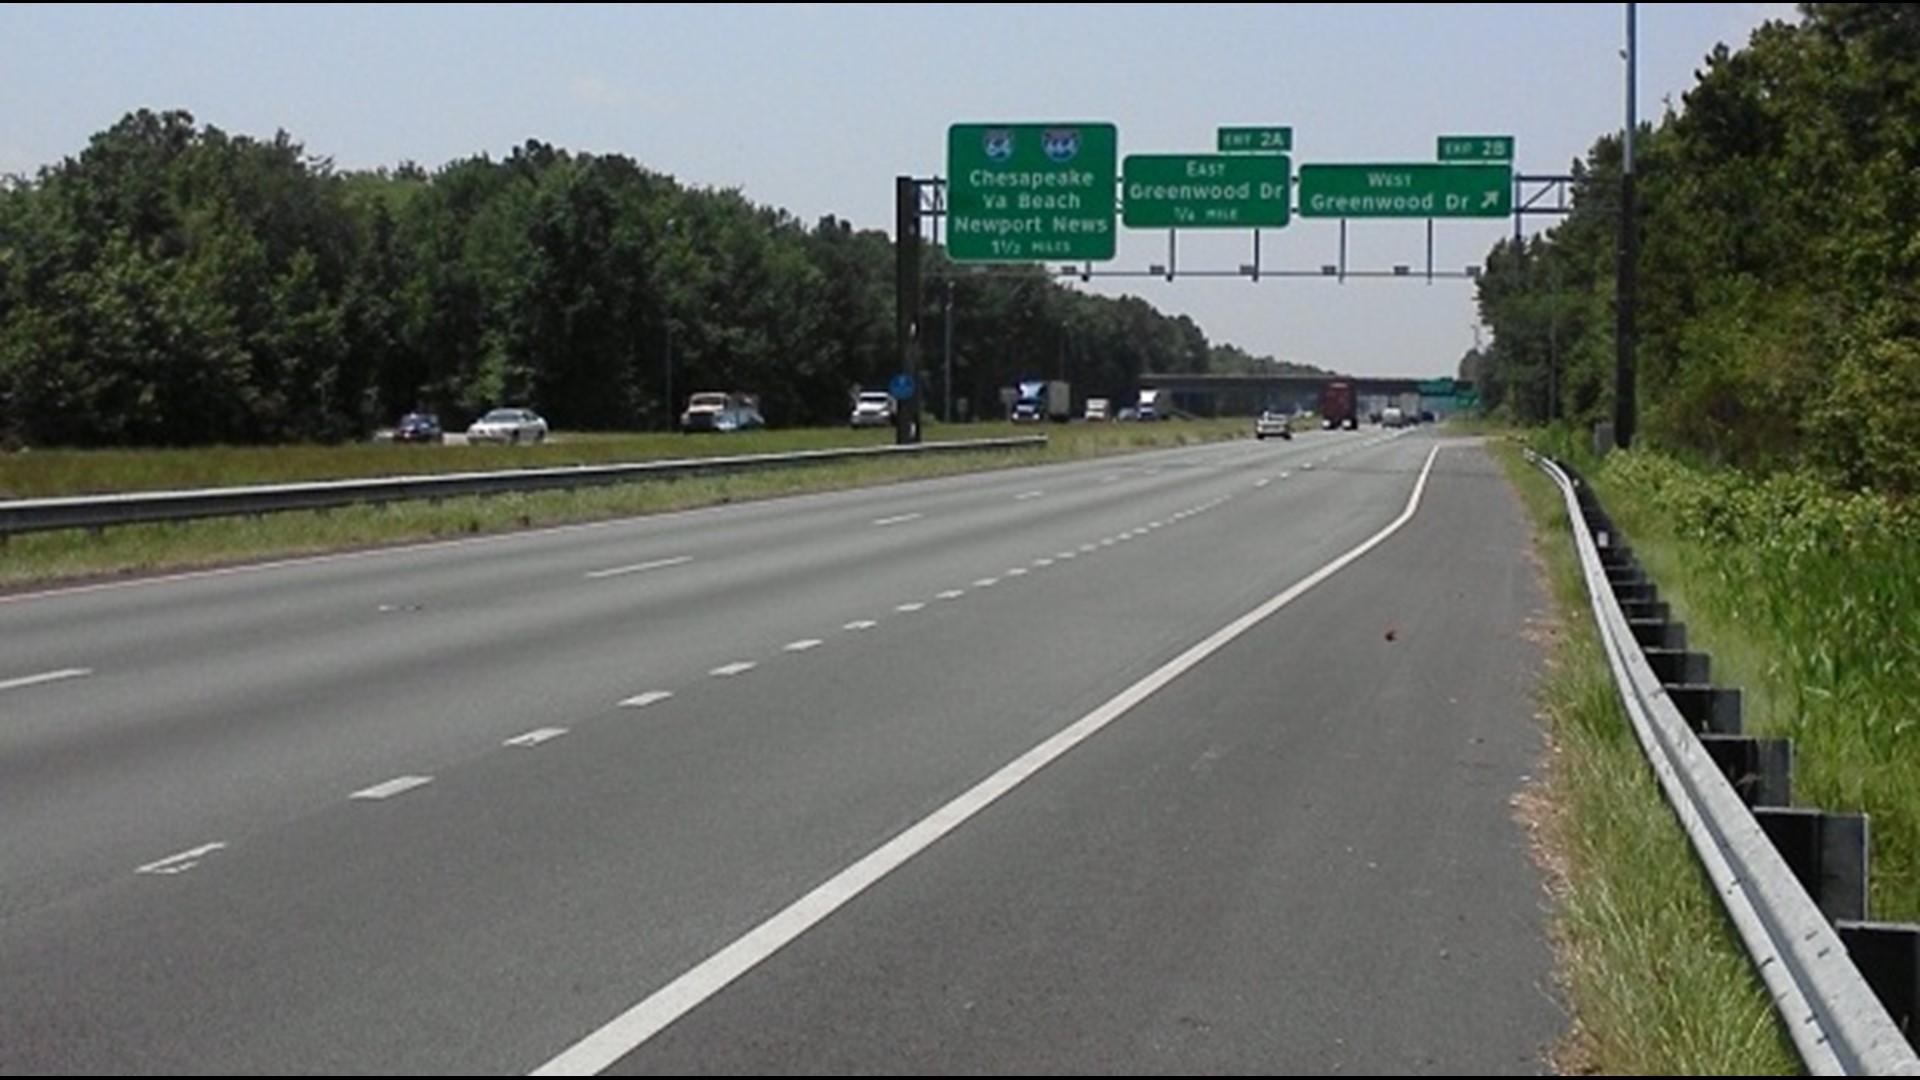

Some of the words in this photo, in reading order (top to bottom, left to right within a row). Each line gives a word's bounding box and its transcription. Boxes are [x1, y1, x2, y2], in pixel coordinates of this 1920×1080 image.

[1260, 131, 1284, 147] 2A
[1482, 140, 1507, 156] 2B
[1185, 160, 1227, 177] EAST
[969, 169, 1094, 190] Chesapeake
[1367, 172, 1412, 188] WEST
[1129, 181, 1248, 200] Greenwood
[1259, 182, 1284, 200] Dr
[982, 193, 1008, 209] Va
[1018, 191, 1081, 210] Beach
[1311, 192, 1433, 211] Greenwood
[1445, 193, 1469, 211] Dr
[1205, 208, 1239, 221] MILE
[954, 215, 1042, 235] Newport
[1052, 215, 1109, 233] News
[1031, 240, 1072, 253] MILES
